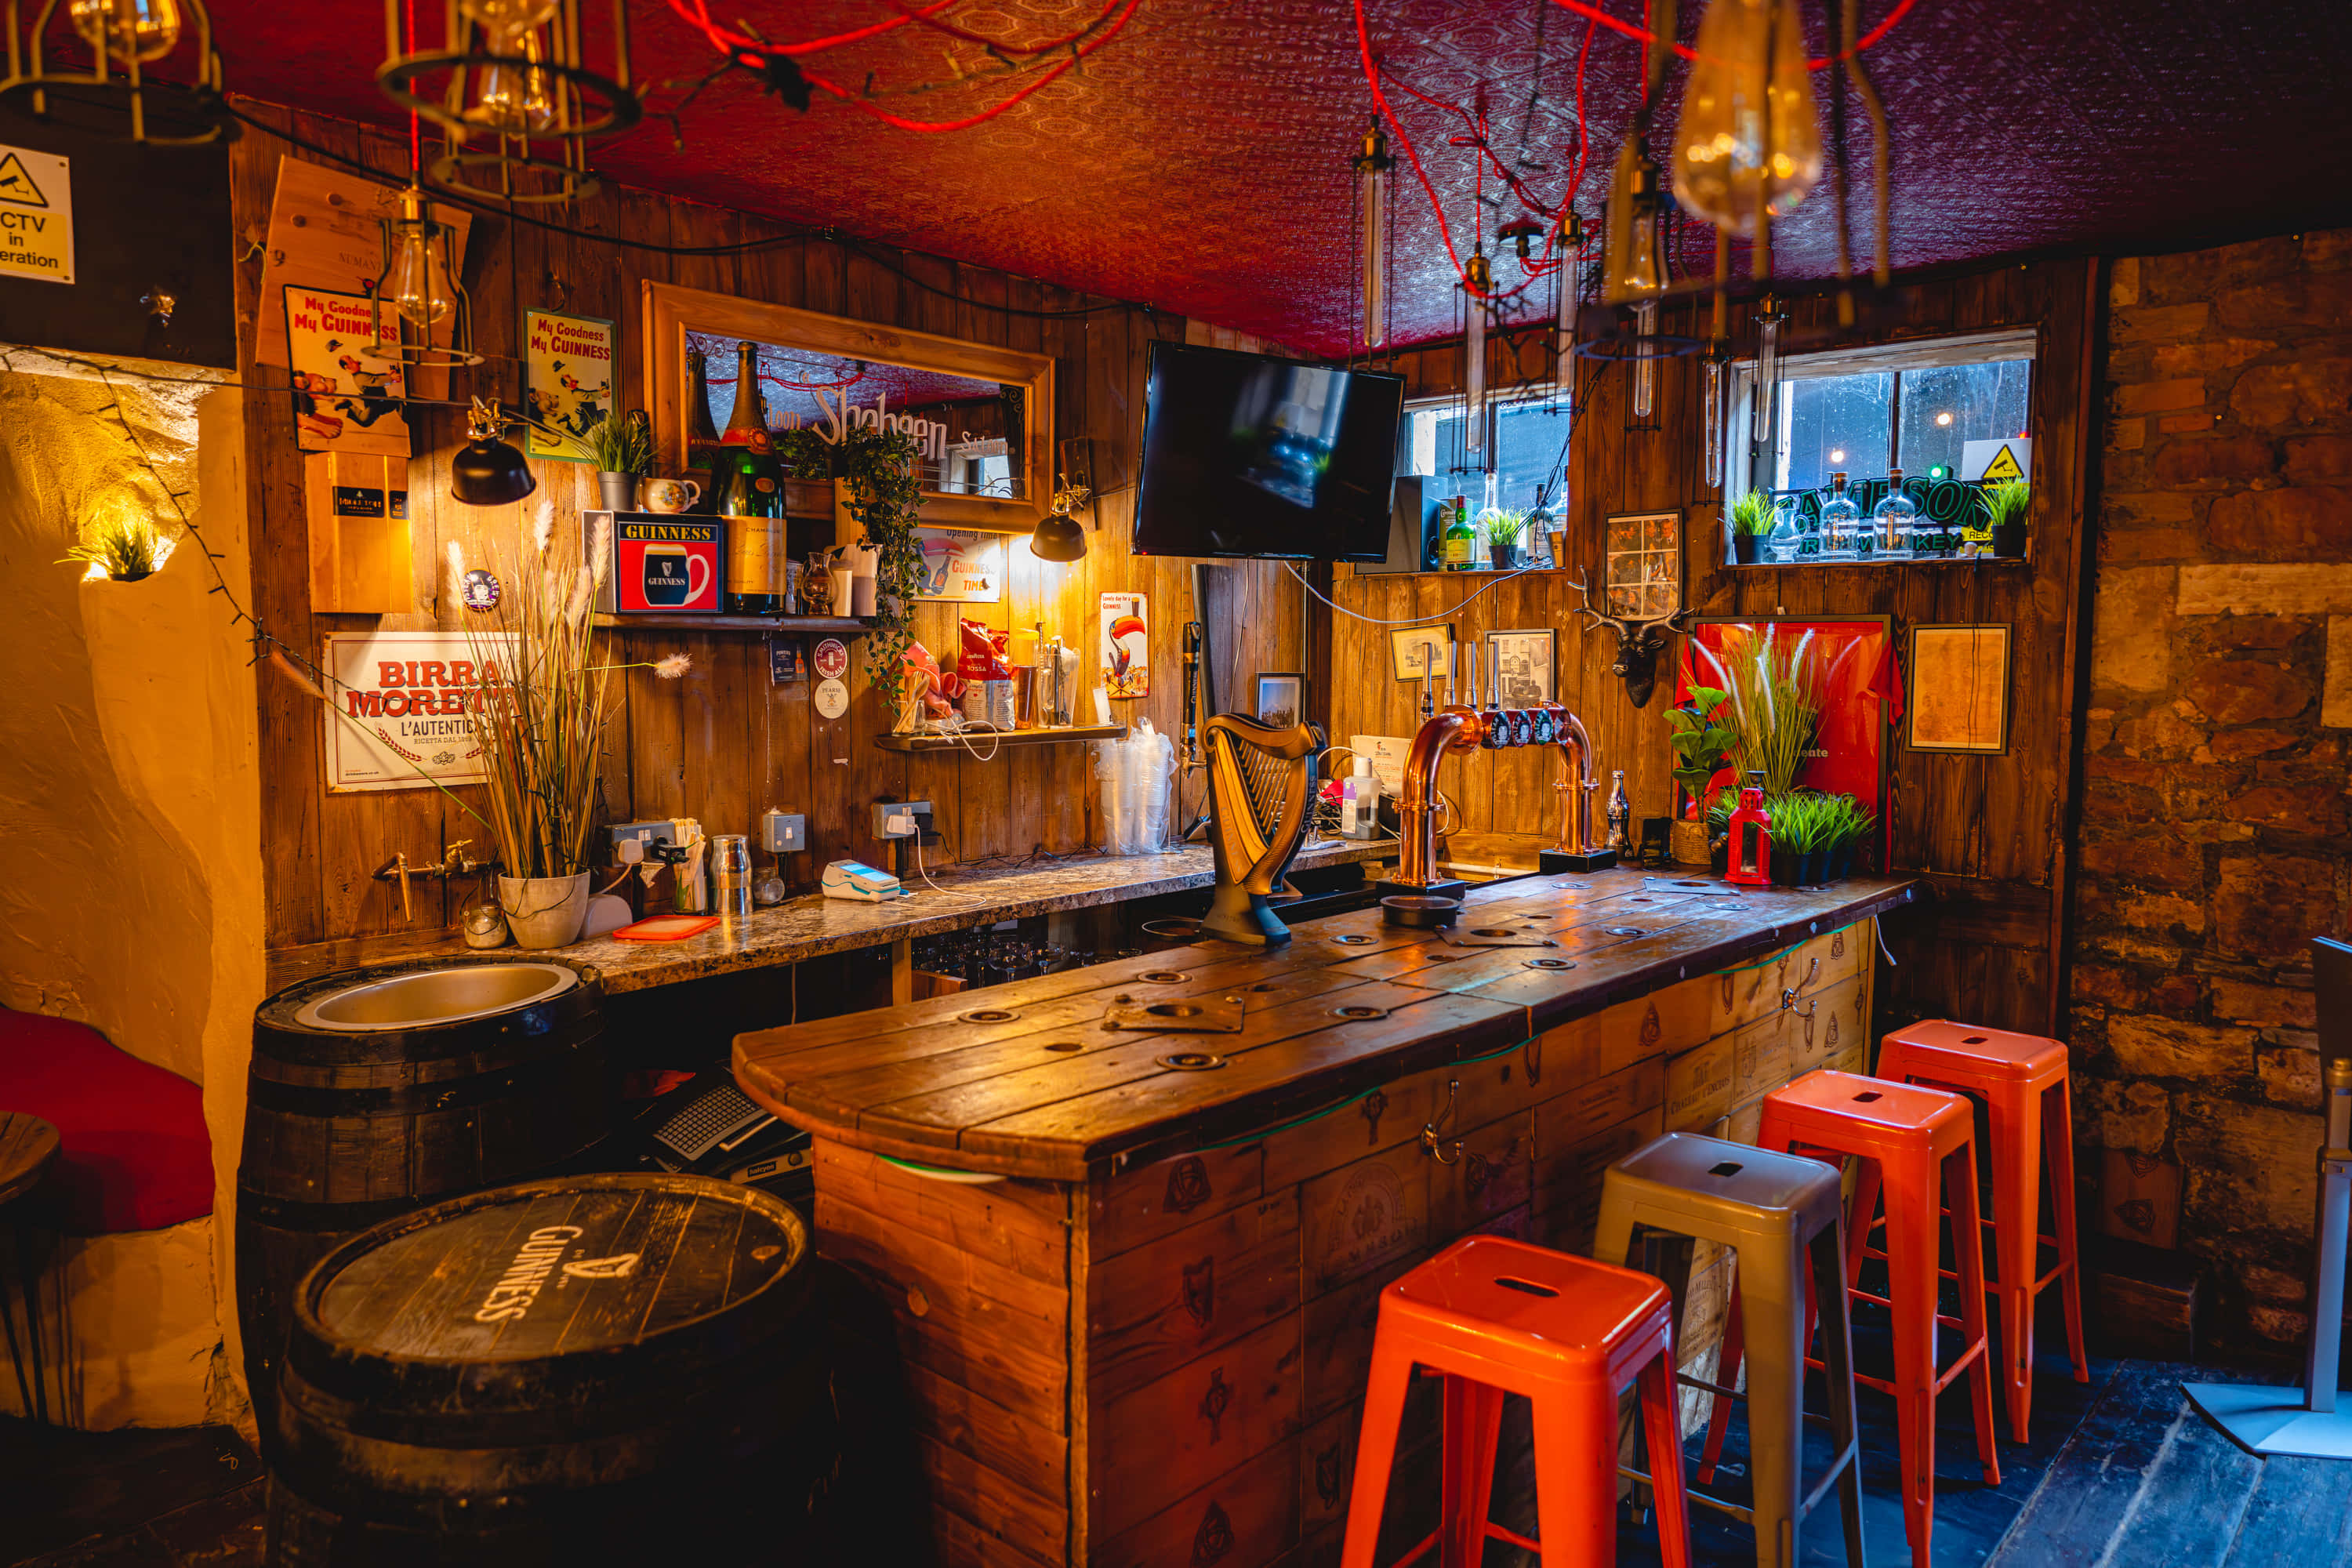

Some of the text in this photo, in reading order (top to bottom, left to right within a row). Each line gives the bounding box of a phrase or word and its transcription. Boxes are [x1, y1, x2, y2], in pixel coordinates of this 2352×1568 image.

[0, 212, 46, 233] CTV
[9, 233, 24, 247] in
[0, 250, 59, 269] eration
[305, 296, 383, 320] My Goodnes
[294, 313, 397, 341] My GUINNSS
[538, 318, 604, 342] My Goodness
[531, 336, 611, 361] My GUINNESS
[626, 524, 711, 541] GUINNESS
[946, 529, 978, 541] Opening
[648, 577, 686, 586] GUINNESS
[401, 720, 480, 736] L'AUTENTIC
[474, 1225, 584, 1323] GUINNESS
